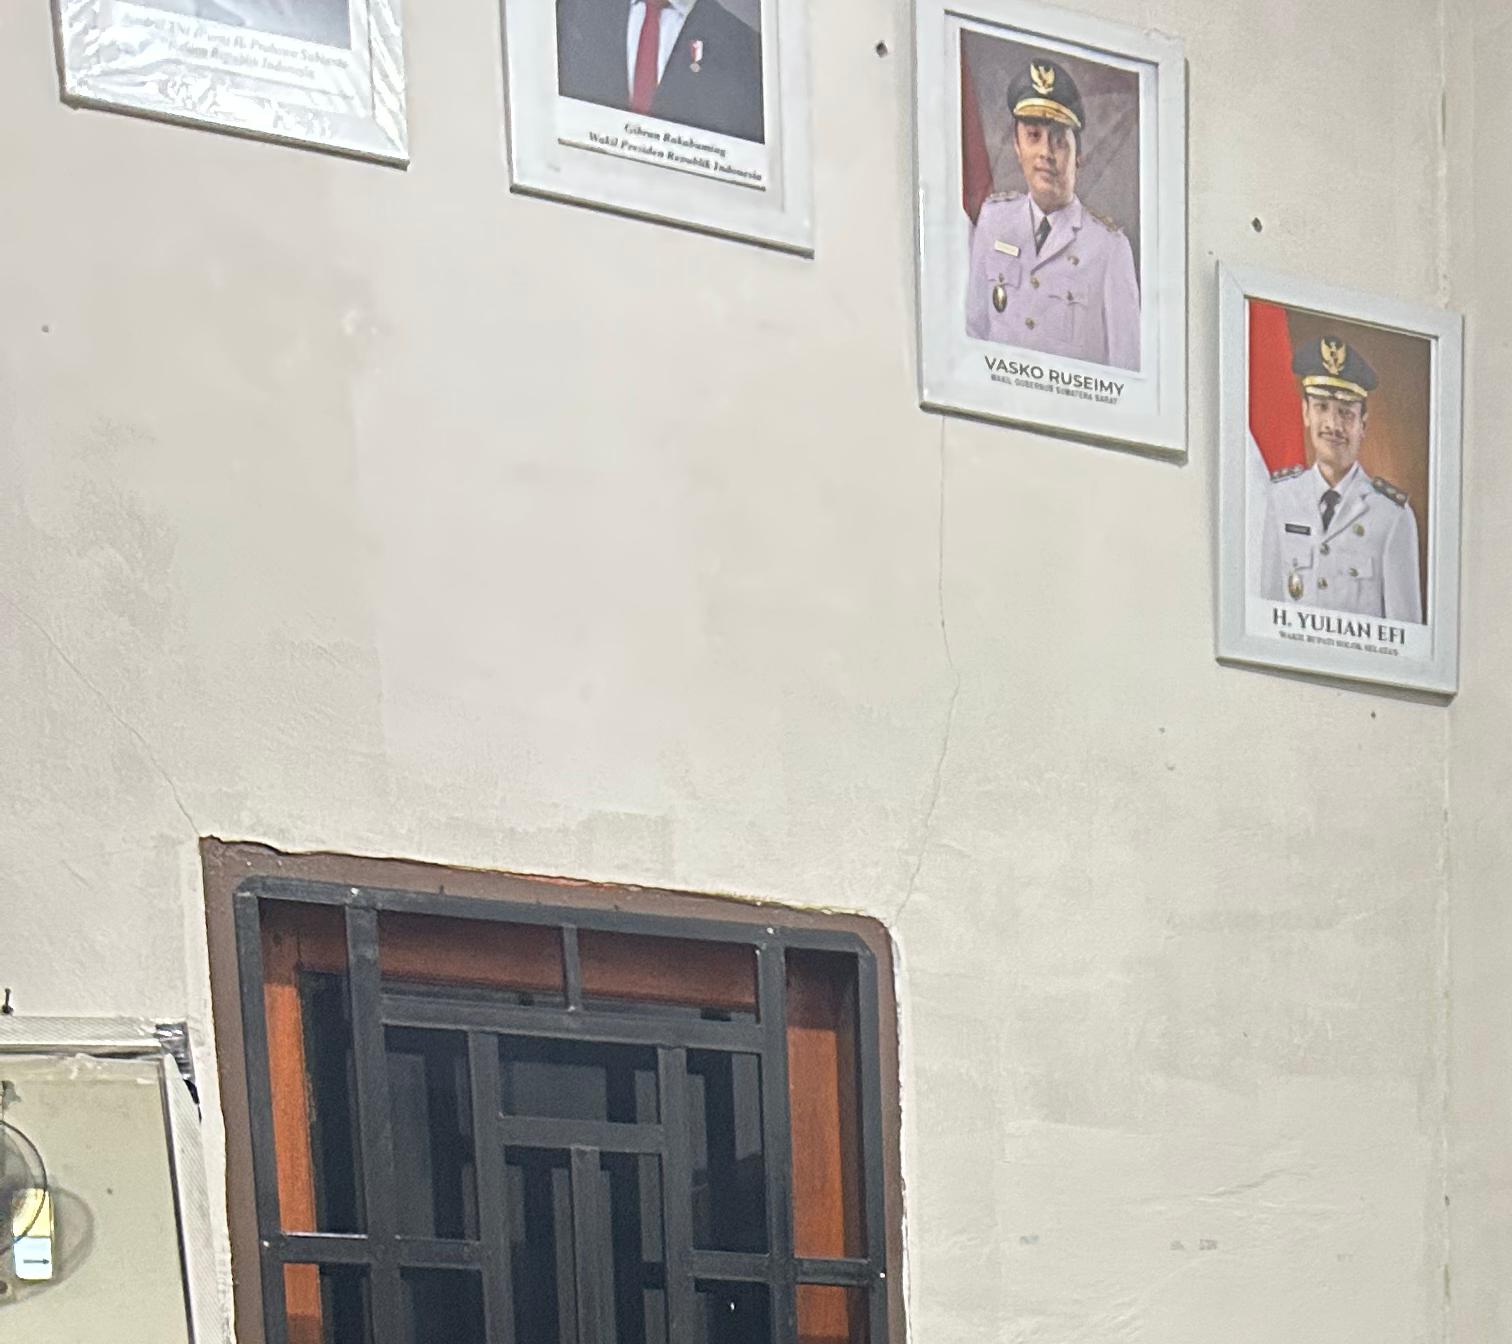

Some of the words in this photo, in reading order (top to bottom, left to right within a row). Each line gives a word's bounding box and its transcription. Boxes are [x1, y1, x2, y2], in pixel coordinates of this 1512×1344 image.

[984, 355, 1044, 380] VASKO
[1049, 369, 1124, 397] RUSEIMY
[1273, 608, 1292, 627] H.
[1297, 612, 1371, 639] YULIAN
[1378, 624, 1405, 645] EFI
